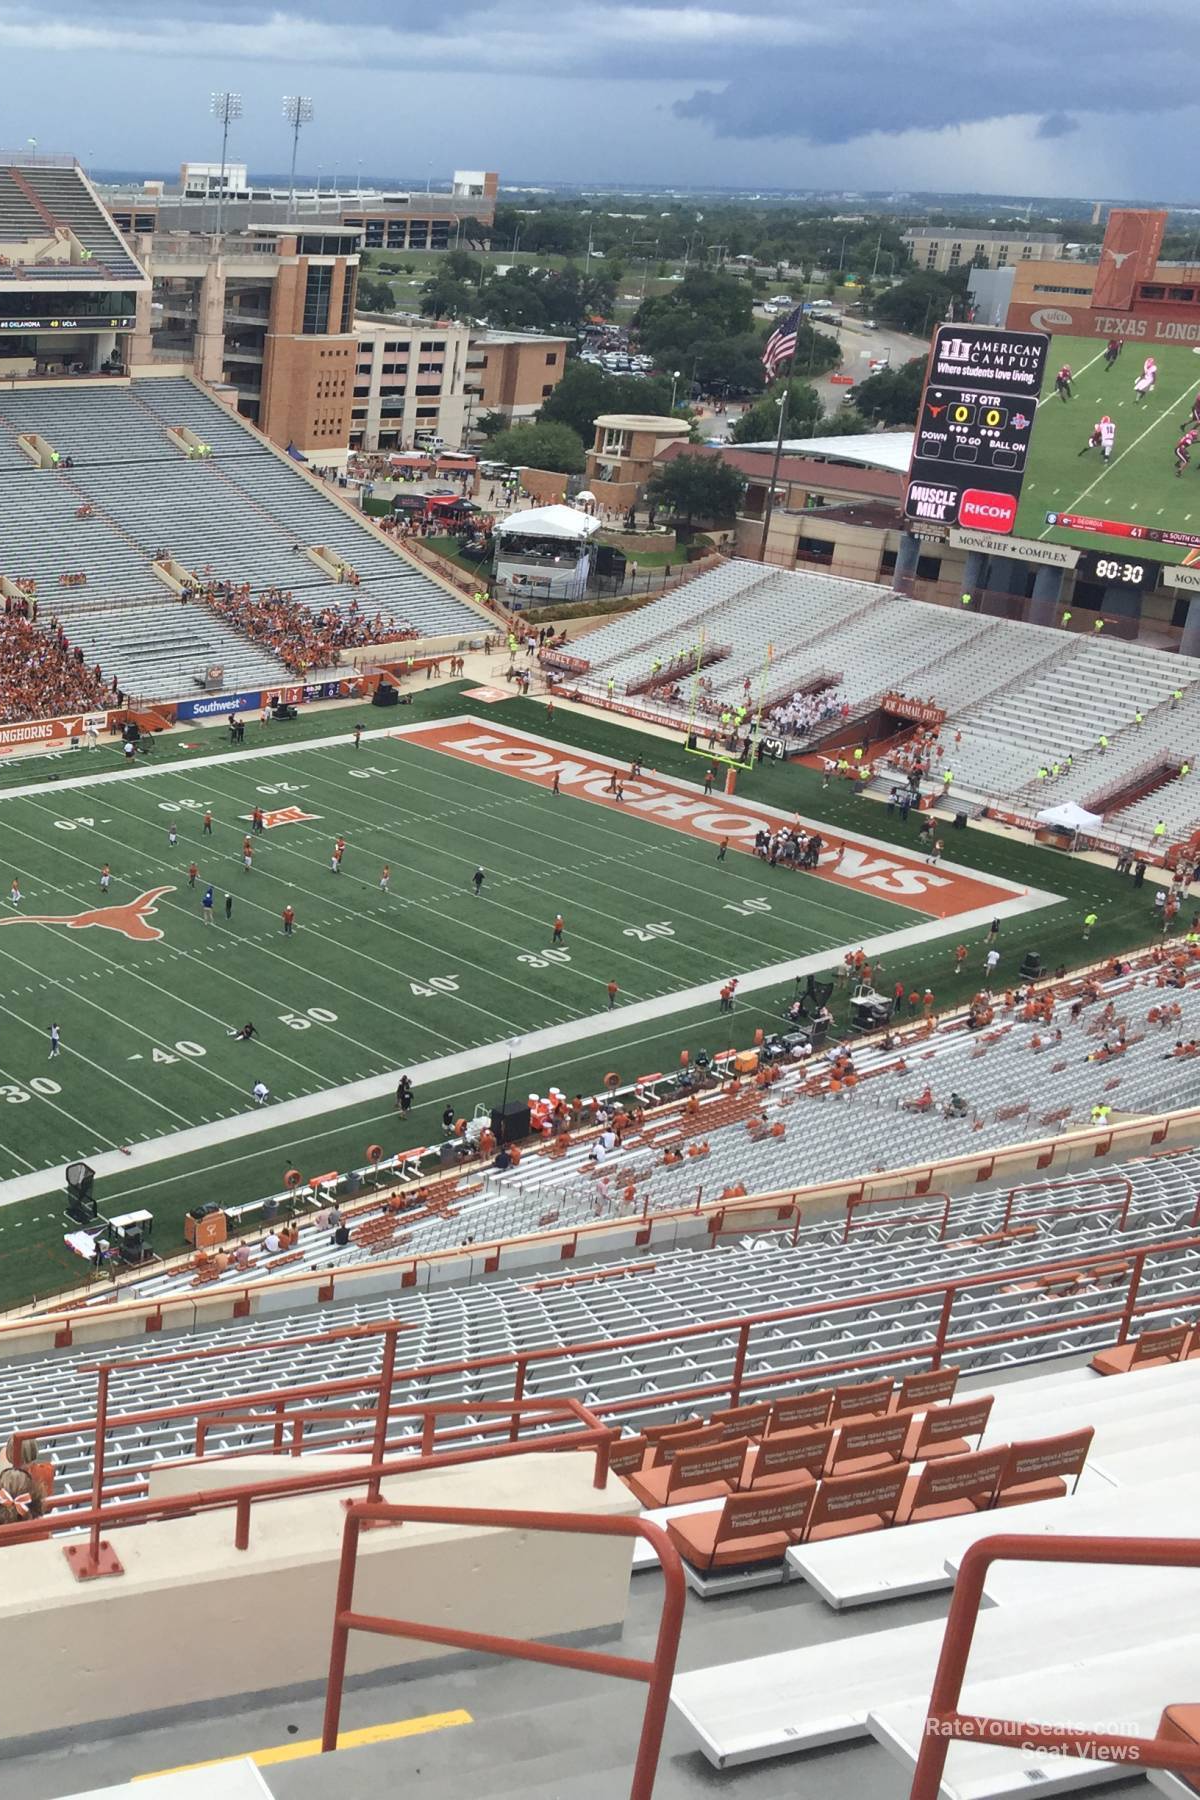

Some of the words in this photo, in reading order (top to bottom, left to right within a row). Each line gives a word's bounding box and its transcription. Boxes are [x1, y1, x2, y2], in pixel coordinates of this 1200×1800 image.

[1094, 316, 1147, 336] TEXAS
[973, 341, 1041, 356] AMERICAN
[971, 352, 1039, 368] CAMPUS
[937, 362, 961, 375] Where
[962, 366, 994, 379] students
[995, 369, 1011, 381] love
[1012, 370, 1036, 384] living.
[960, 393, 978, 403] 1ST
[979, 396, 1001, 406] QTR
[955, 406, 968, 422] 0
[986, 410, 1000, 426] 0
[921, 431, 947, 442] DOWN
[955, 435, 967, 444] TO
[968, 437, 981, 446] GO
[989, 440, 1010, 450] BALL
[1012, 443, 1026, 452] ON
[910, 486, 957, 507] MUSCLE
[916, 501, 946, 520] MILK
[964, 503, 1012, 520] RICOH
[1130, 528, 1143, 538] 41
[1170, 533, 1190, 543] SOUTH
[958, 536, 1009, 553] MONCRIEF
[1018, 546, 1068, 563] COMPLEX
[1096, 560, 1144, 583] 80:30
[193, 698, 240, 714] Southwest
[884, 700, 897, 711] JOE
[897, 704, 921, 718] JAMAIL
[349, 766, 388, 779] 10
[256, 782, 301, 795] 20
[158, 798, 205, 812] 30
[54, 816, 94, 830] 40
[440, 734, 954, 896] LONGHONS
[723, 898, 772, 916] 10
[623, 923, 676, 943] 20
[516, 949, 572, 969] 30
[409, 976, 460, 998] 40
[278, 1007, 338, 1031] 50
[150, 1040, 207, 1065] 40
